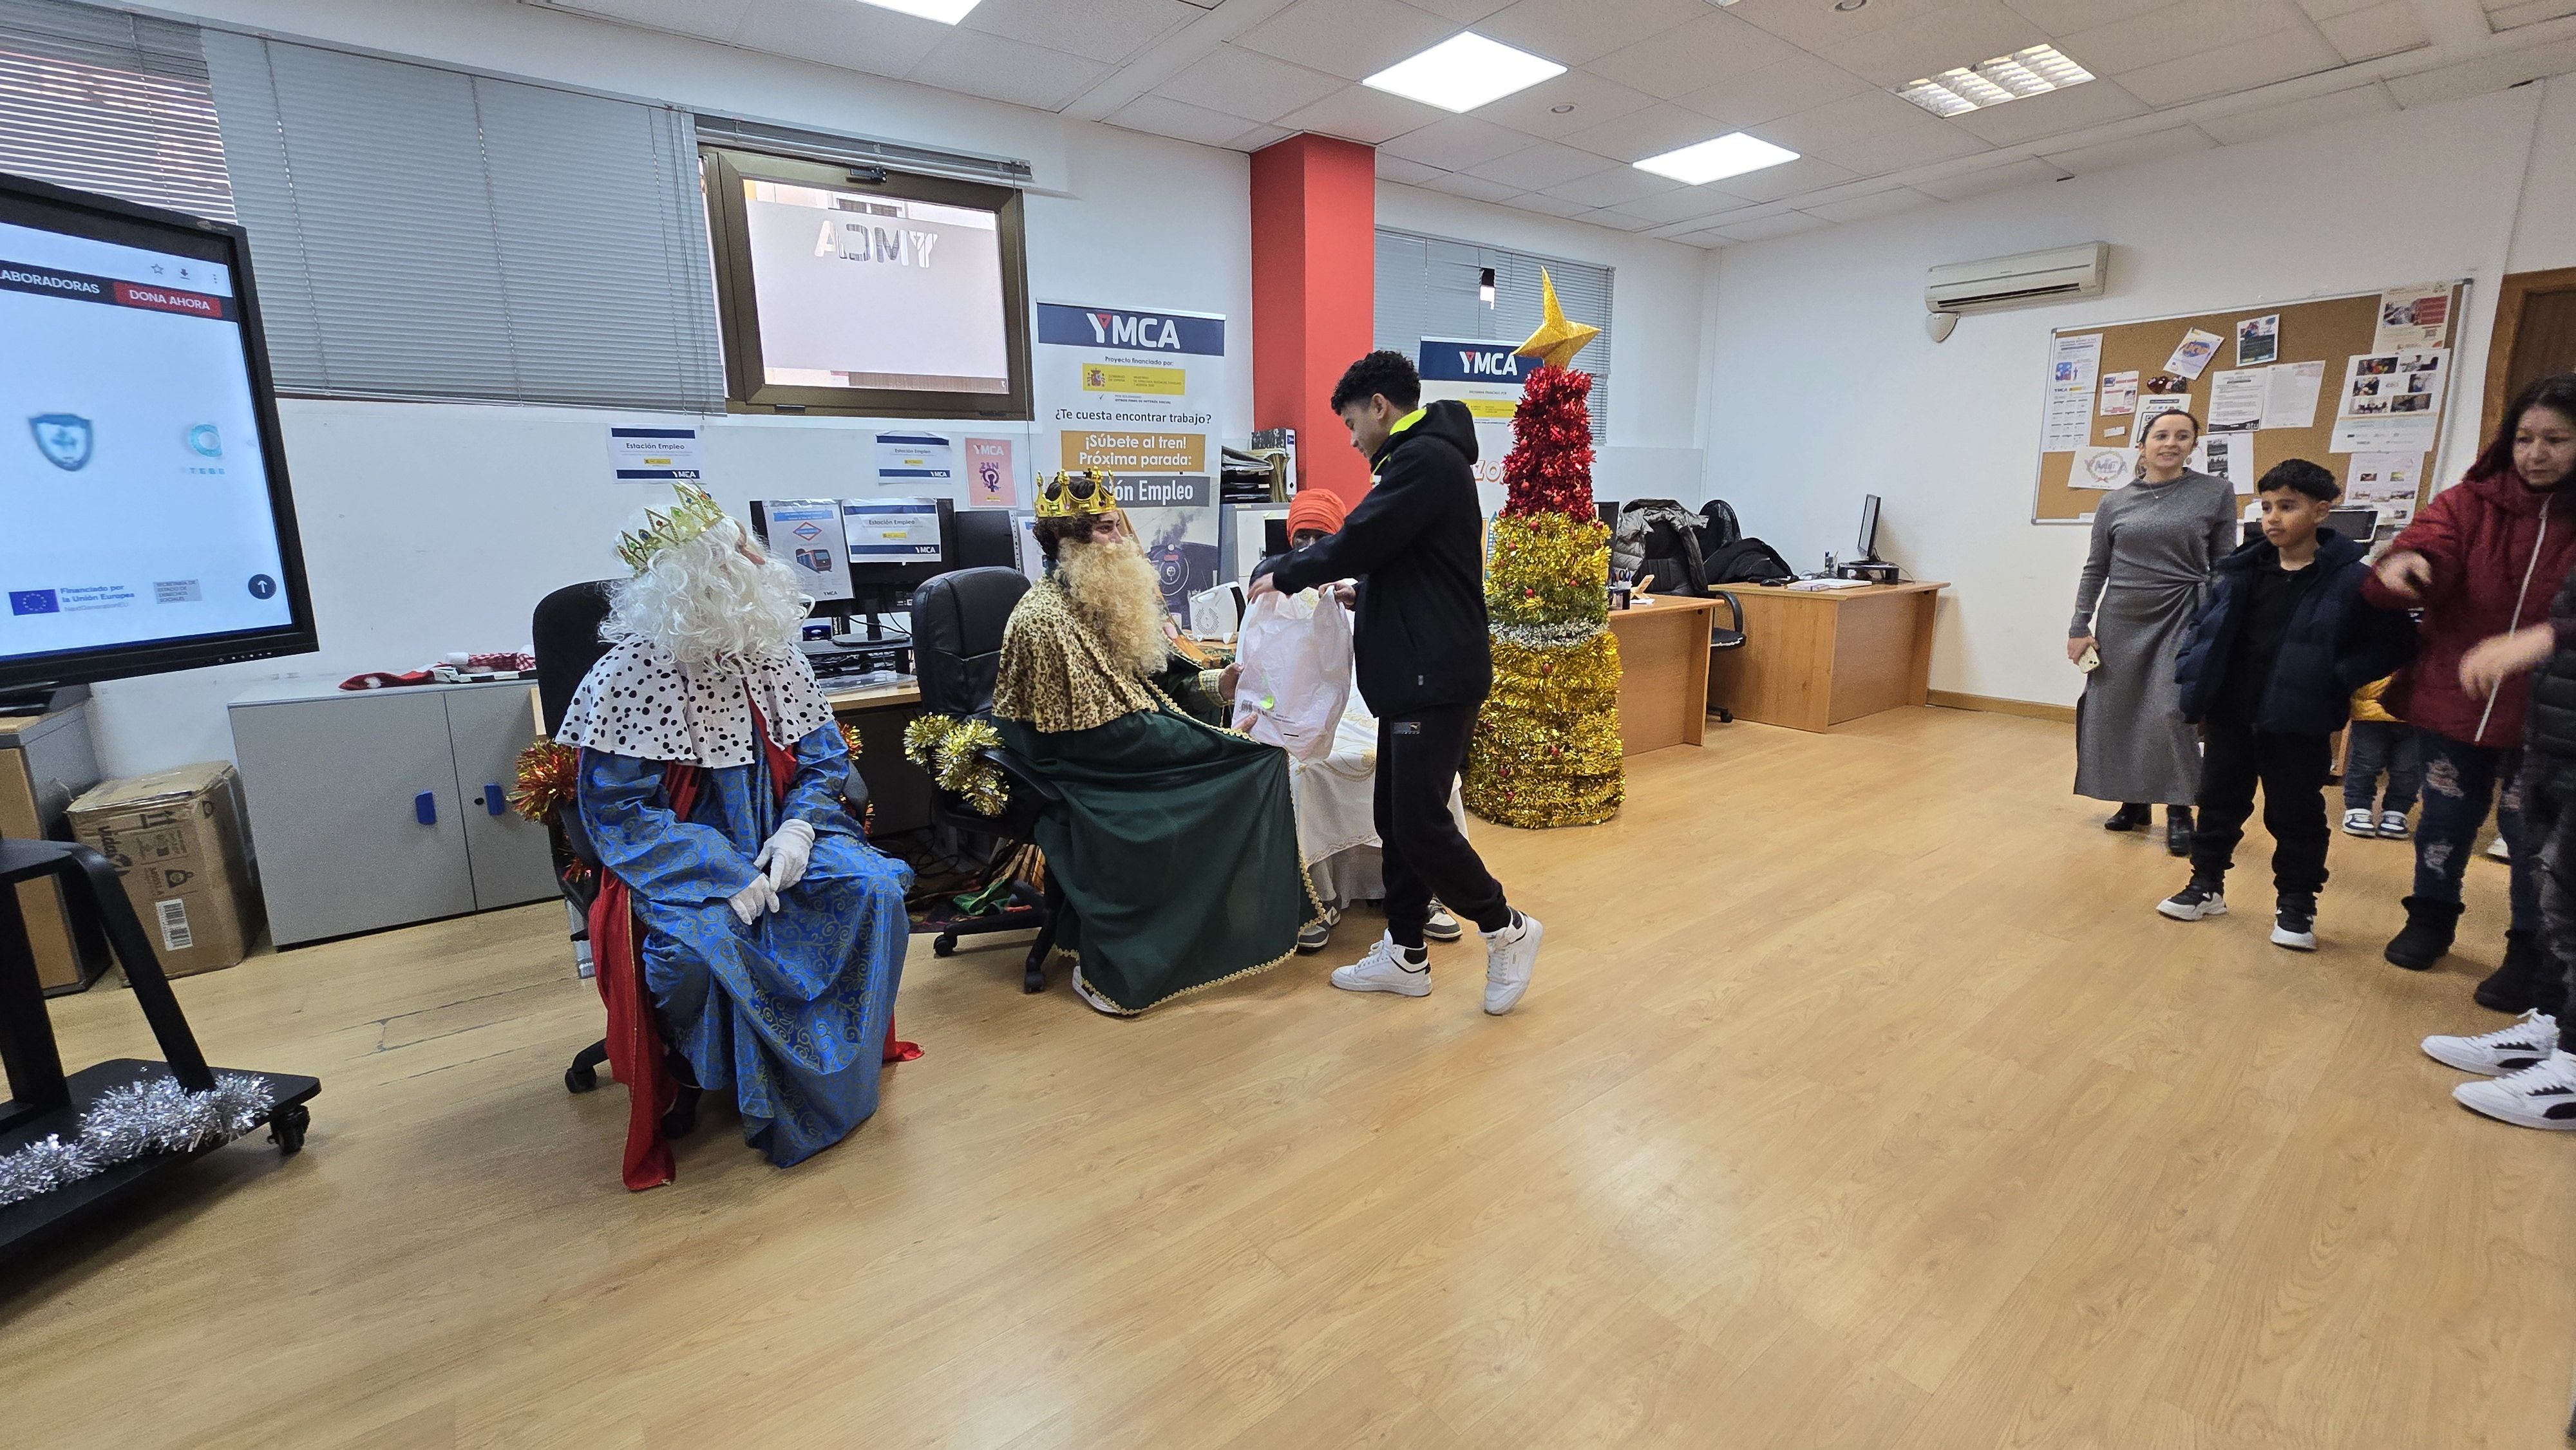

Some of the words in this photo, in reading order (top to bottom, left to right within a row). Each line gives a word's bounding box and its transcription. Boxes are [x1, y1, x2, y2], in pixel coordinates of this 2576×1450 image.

[129, 290, 166, 305] DONA
[169, 295, 211, 310] AHORA
[1086, 312, 1180, 349] YMCA
[1132, 357, 1162, 366] financiado
[1459, 351, 1518, 375] YMCA
[1056, 408, 1073, 420] ¿Te
[1076, 410, 1112, 421] cuesta
[1115, 412, 1166, 422] encontrar
[1170, 413, 1212, 426] trabajo?
[973, 444, 1004, 456] YMCA
[1085, 433, 1139, 450] ¡Súbete
[1142, 437, 1155, 449] al
[1159, 437, 1186, 449] tren!
[1079, 451, 1137, 466] Próxima
[1141, 453, 1191, 468] parada:
[1139, 480, 1193, 505] Empleo
